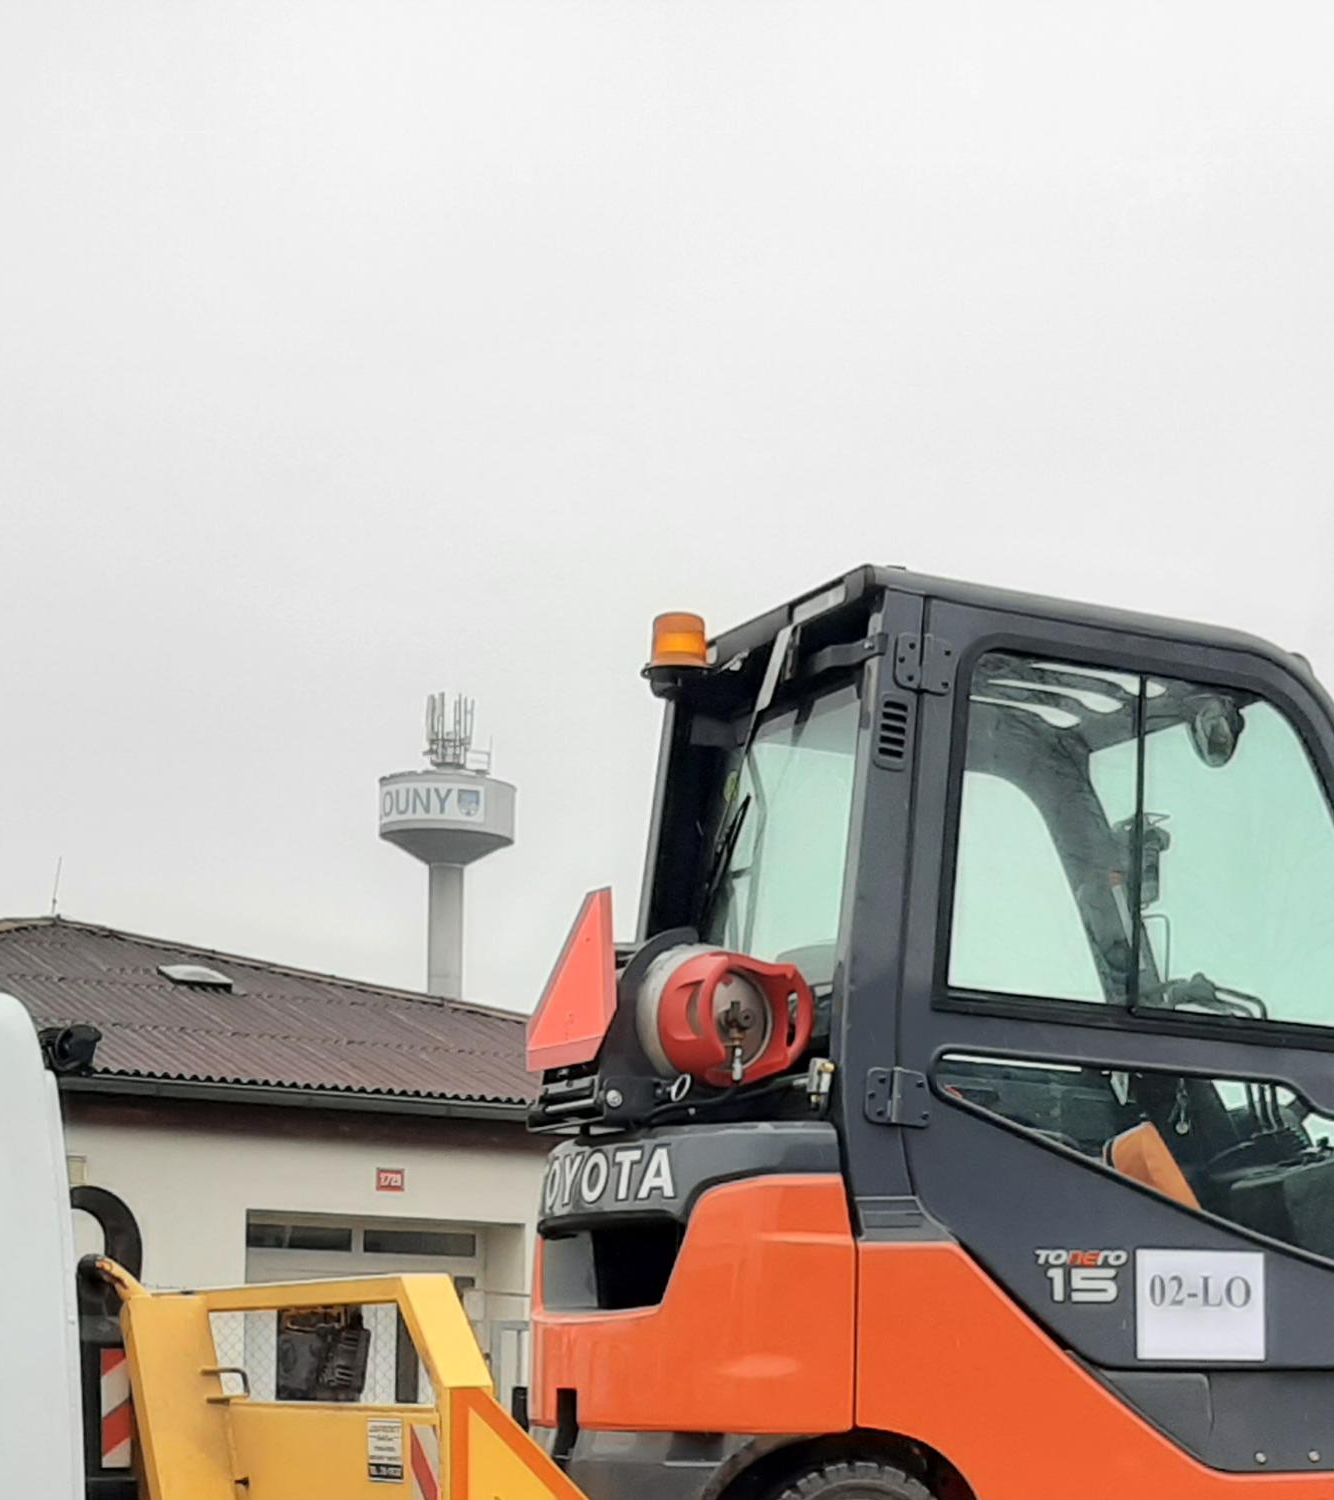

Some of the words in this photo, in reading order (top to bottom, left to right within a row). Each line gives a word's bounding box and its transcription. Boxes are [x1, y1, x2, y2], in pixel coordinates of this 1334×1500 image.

[381, 787, 454, 818] OUNY
[544, 1147, 676, 1215] OYOTA
[1046, 1267, 1118, 1303] 15
[1149, 1274, 1252, 1309] 02-LO
